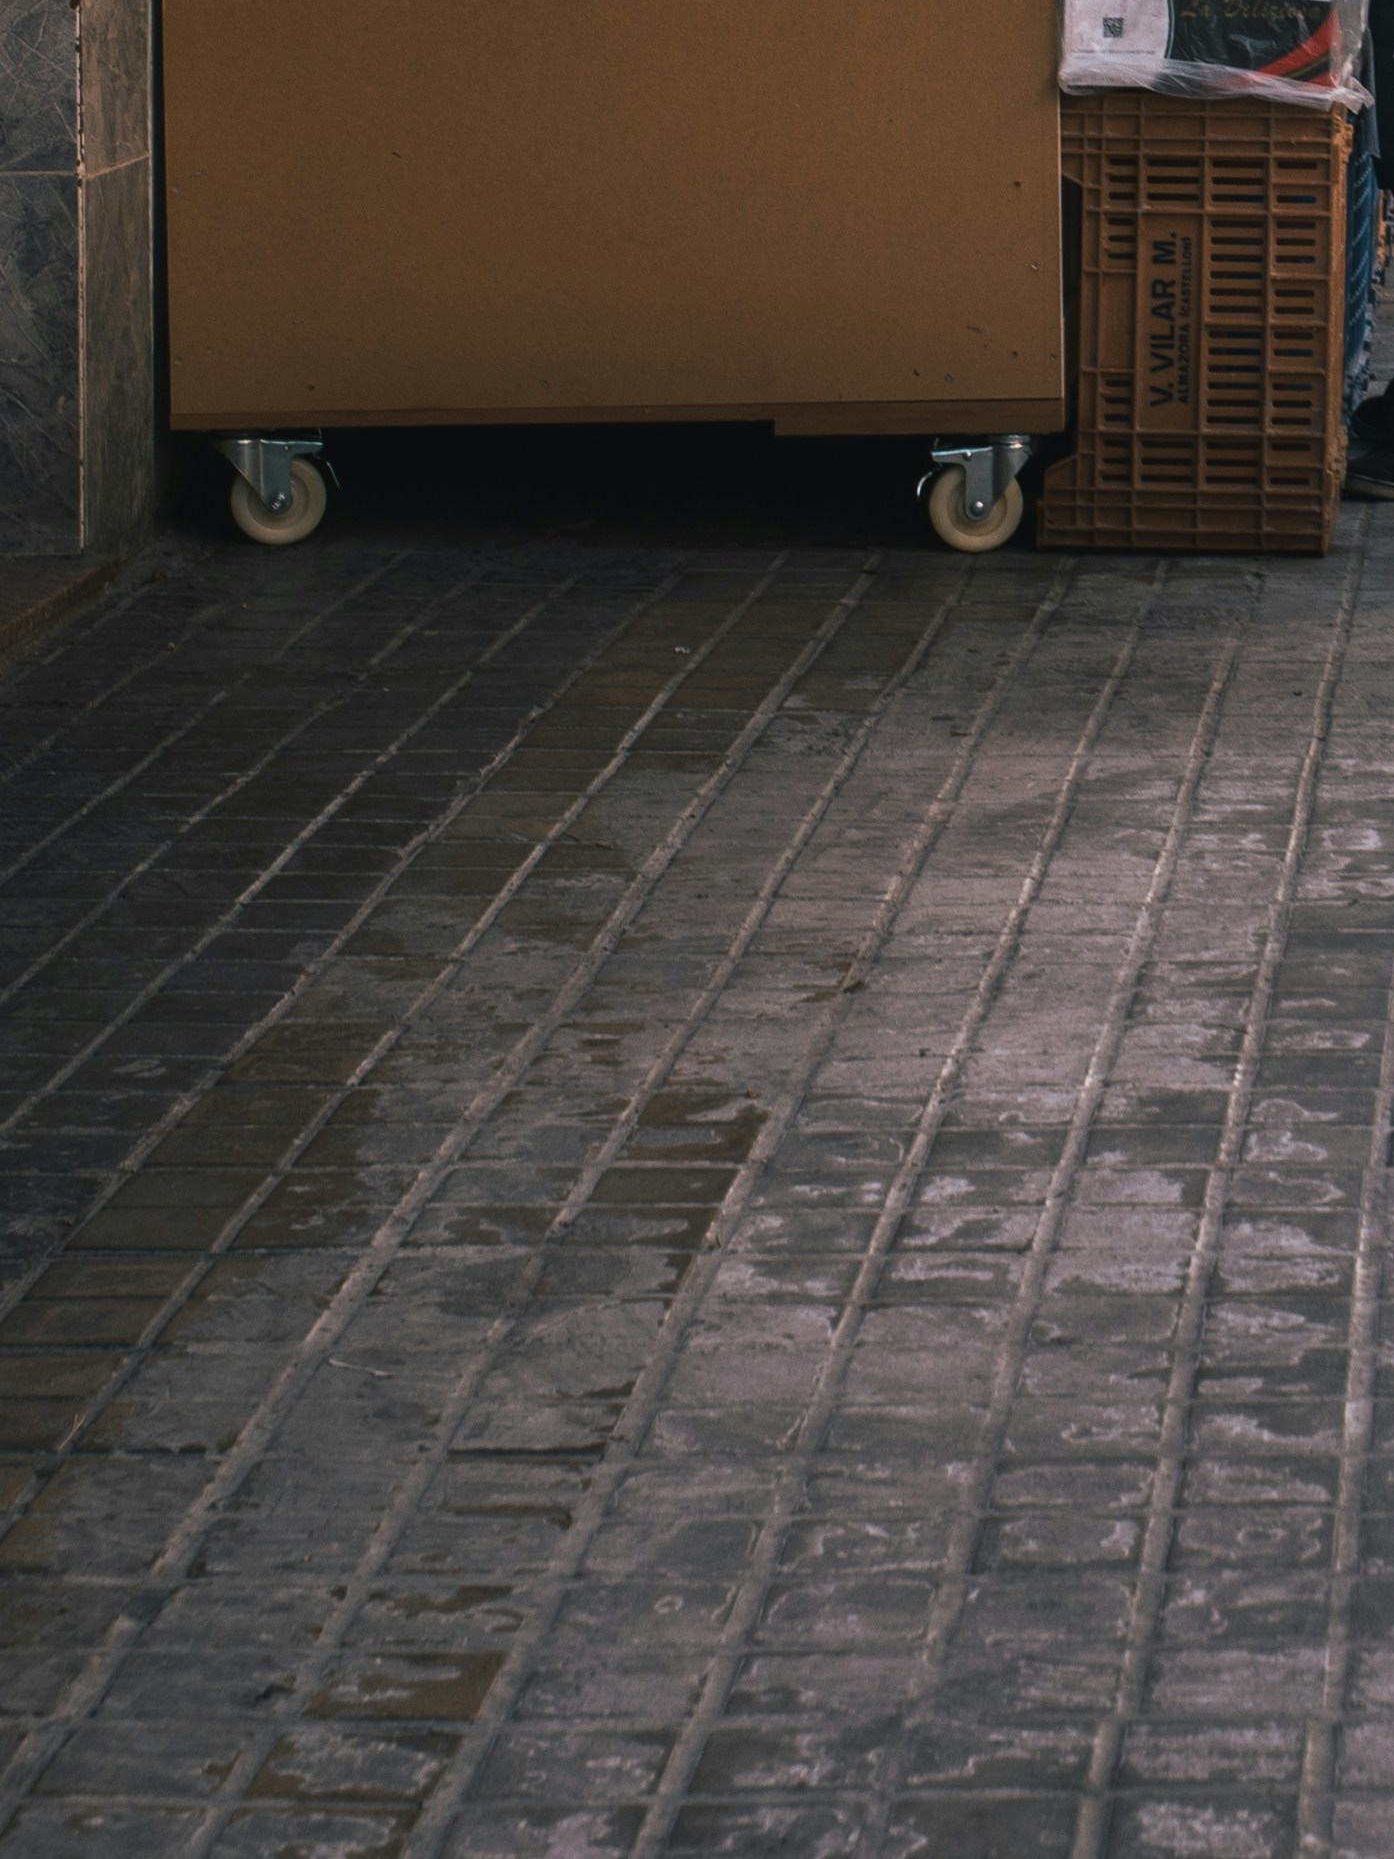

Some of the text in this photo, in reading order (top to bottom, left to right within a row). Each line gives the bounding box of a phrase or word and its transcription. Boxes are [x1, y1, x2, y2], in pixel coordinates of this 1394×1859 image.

[1149, 232, 1178, 407] V. VILAR M.
[1178, 323, 1190, 404] ALMAZORA
